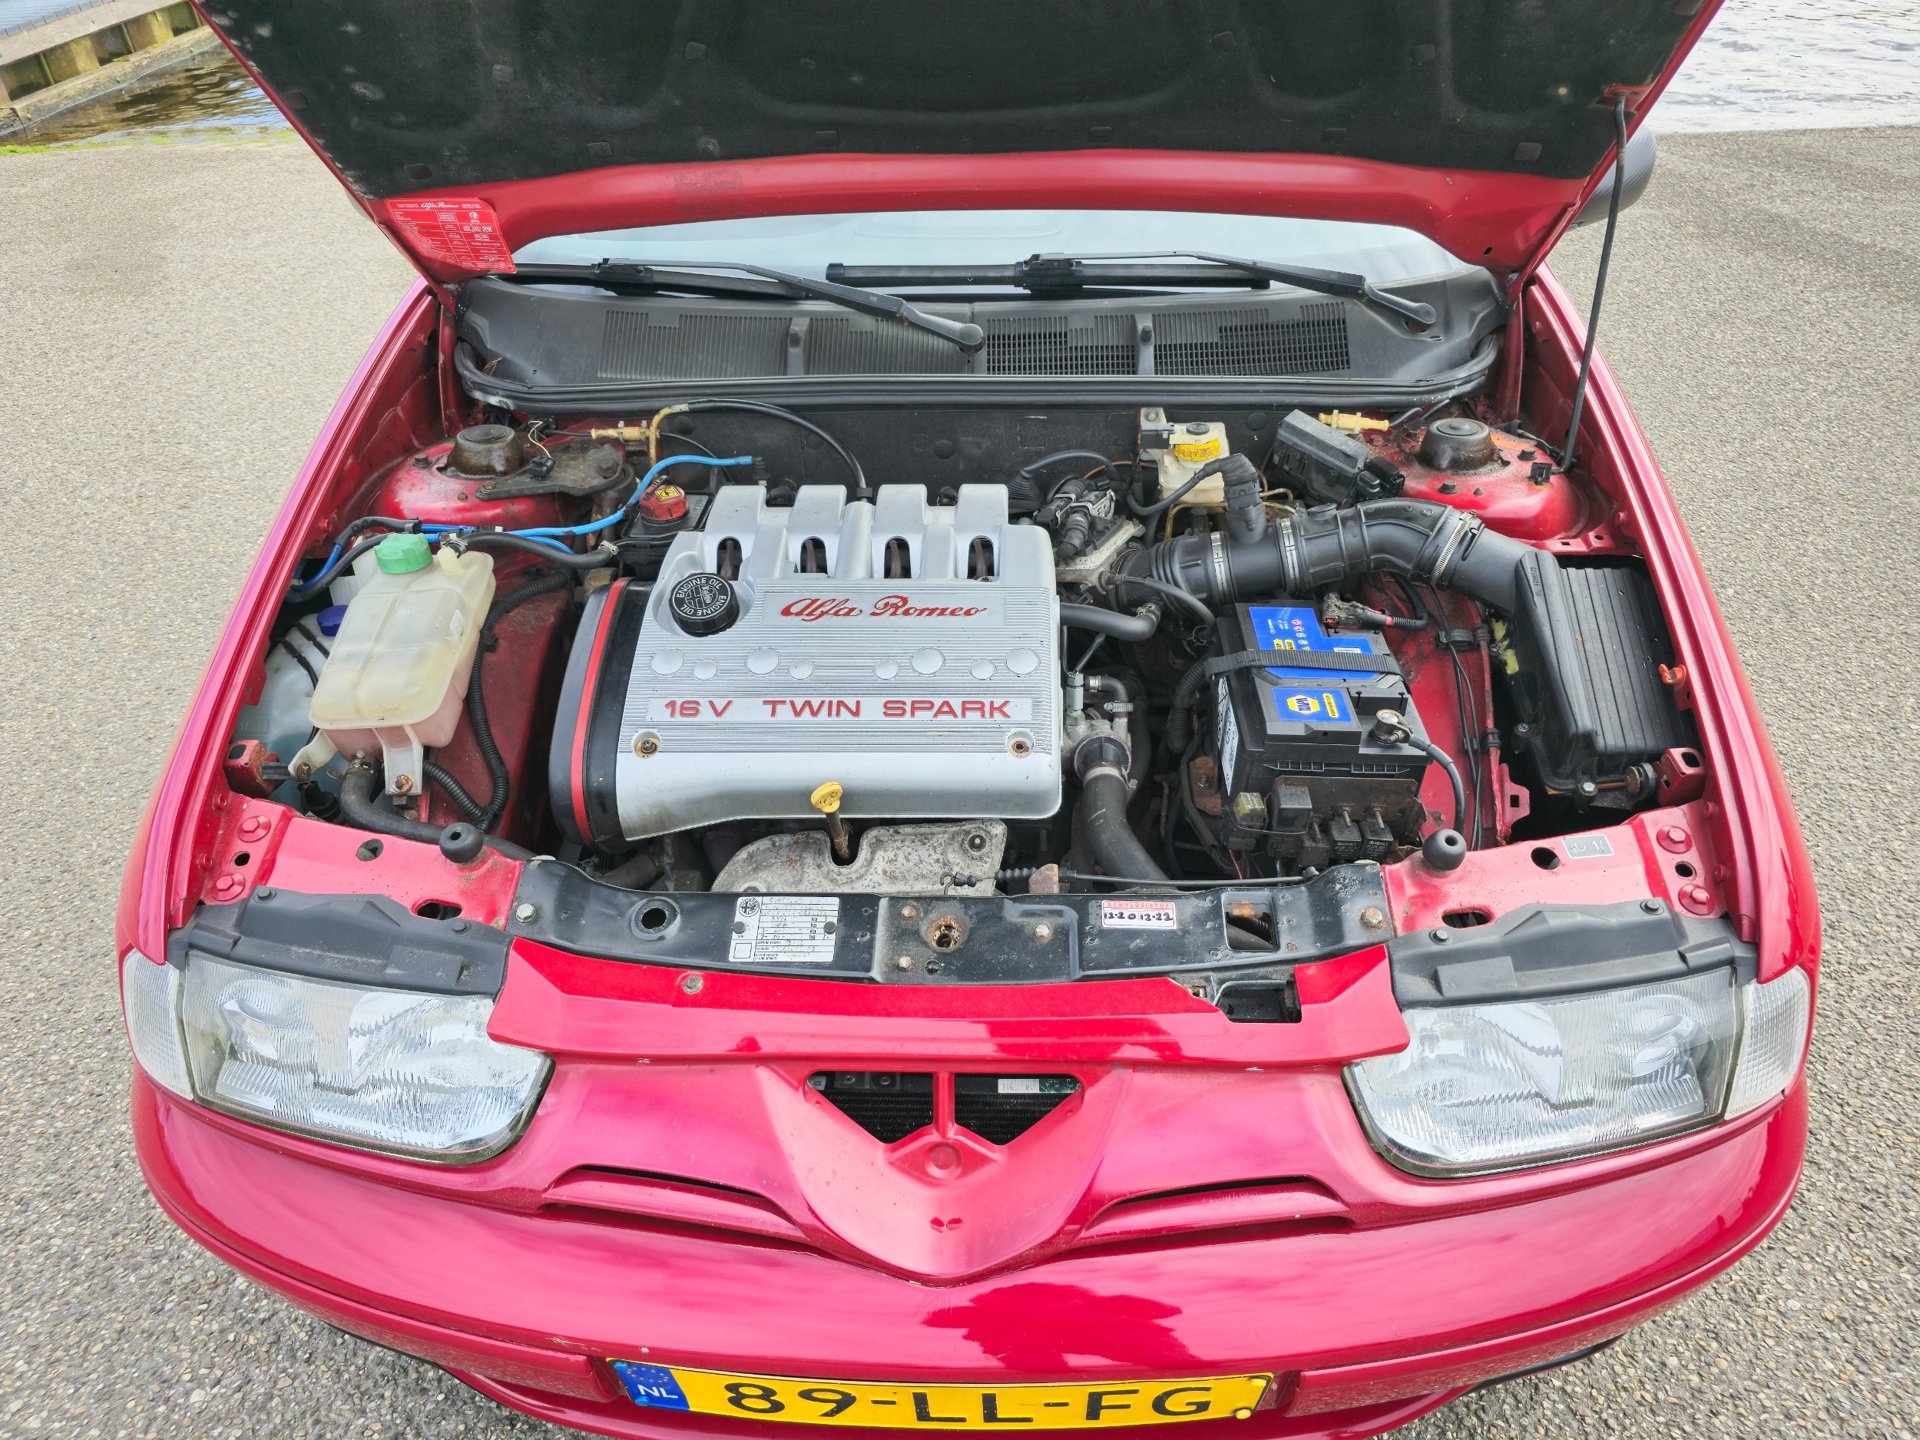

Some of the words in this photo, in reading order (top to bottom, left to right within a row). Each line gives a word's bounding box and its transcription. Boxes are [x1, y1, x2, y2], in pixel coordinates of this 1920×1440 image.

[676, 577, 708, 598] ENGINE
[709, 578, 723, 590] OIL
[680, 604, 695, 615] OIL
[696, 595, 727, 616] ENGINE
[780, 597, 864, 622] Alfa
[869, 594, 988, 618] Romeo
[665, 699, 734, 719] 16V
[762, 699, 862, 718] TWIN
[883, 699, 1011, 719] SPARK
[637, 1383, 678, 1401] NL
[724, 1381, 1212, 1423] 89-LL-FG
